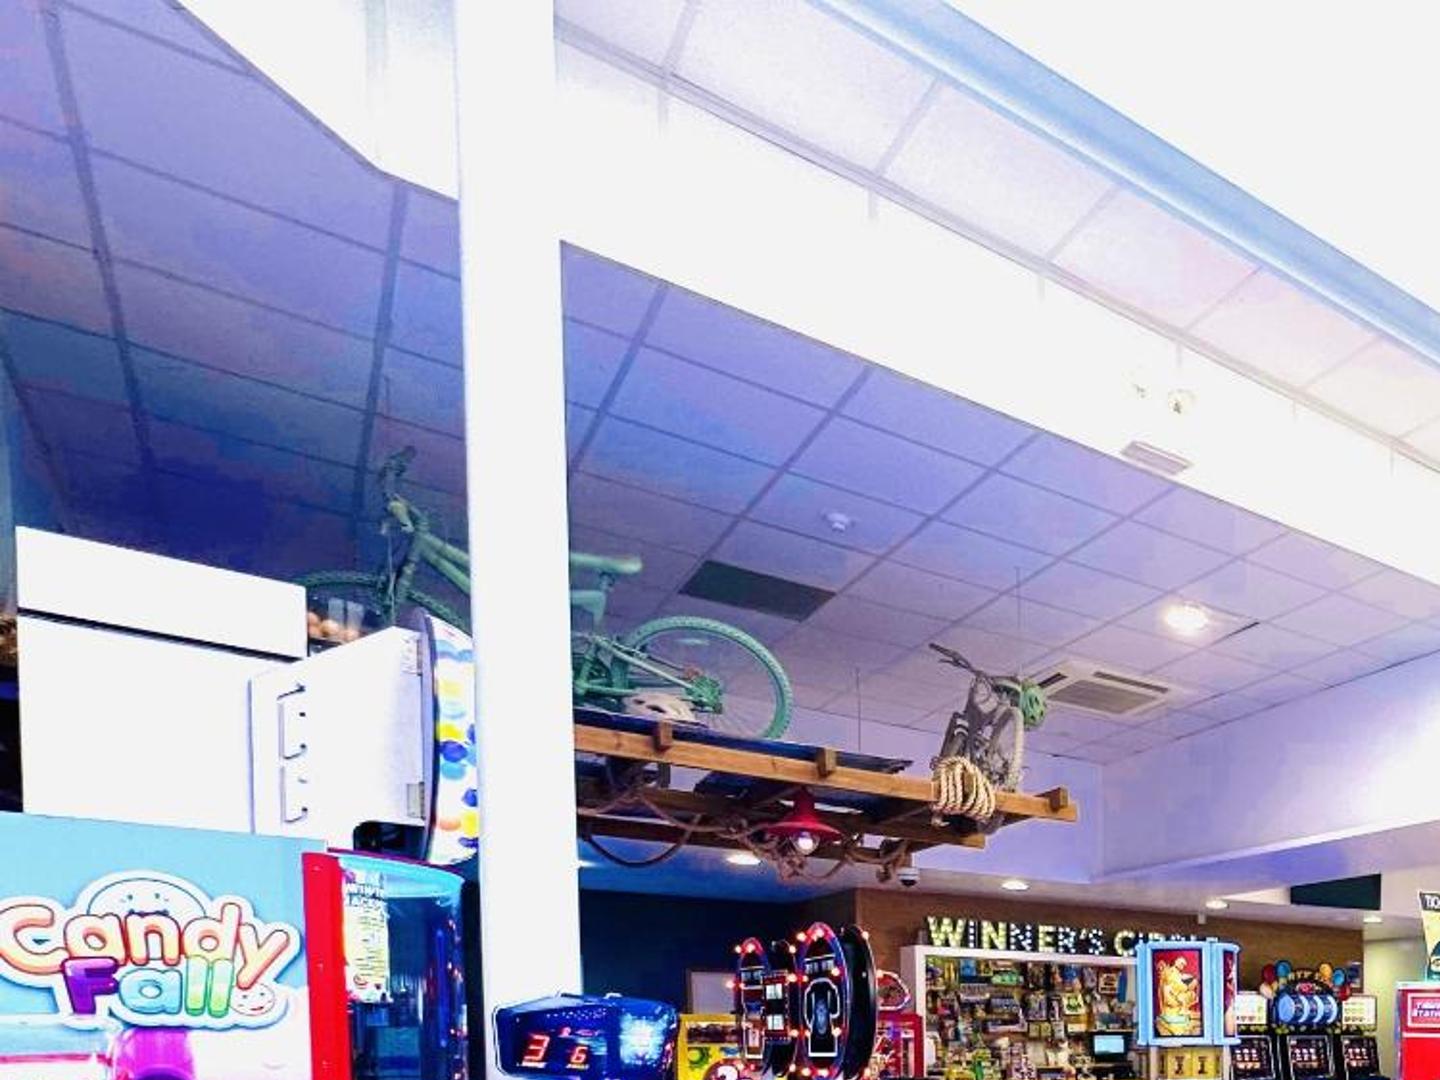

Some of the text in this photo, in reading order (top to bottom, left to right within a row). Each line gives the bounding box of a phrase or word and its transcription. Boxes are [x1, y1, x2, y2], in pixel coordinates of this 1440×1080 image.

[0, 901, 290, 990] Candy
[927, 916, 1104, 956] WINNER'S
[62, 955, 234, 1018] Fall
[520, 1033, 550, 1062] 3
[570, 1046, 589, 1064] 6
